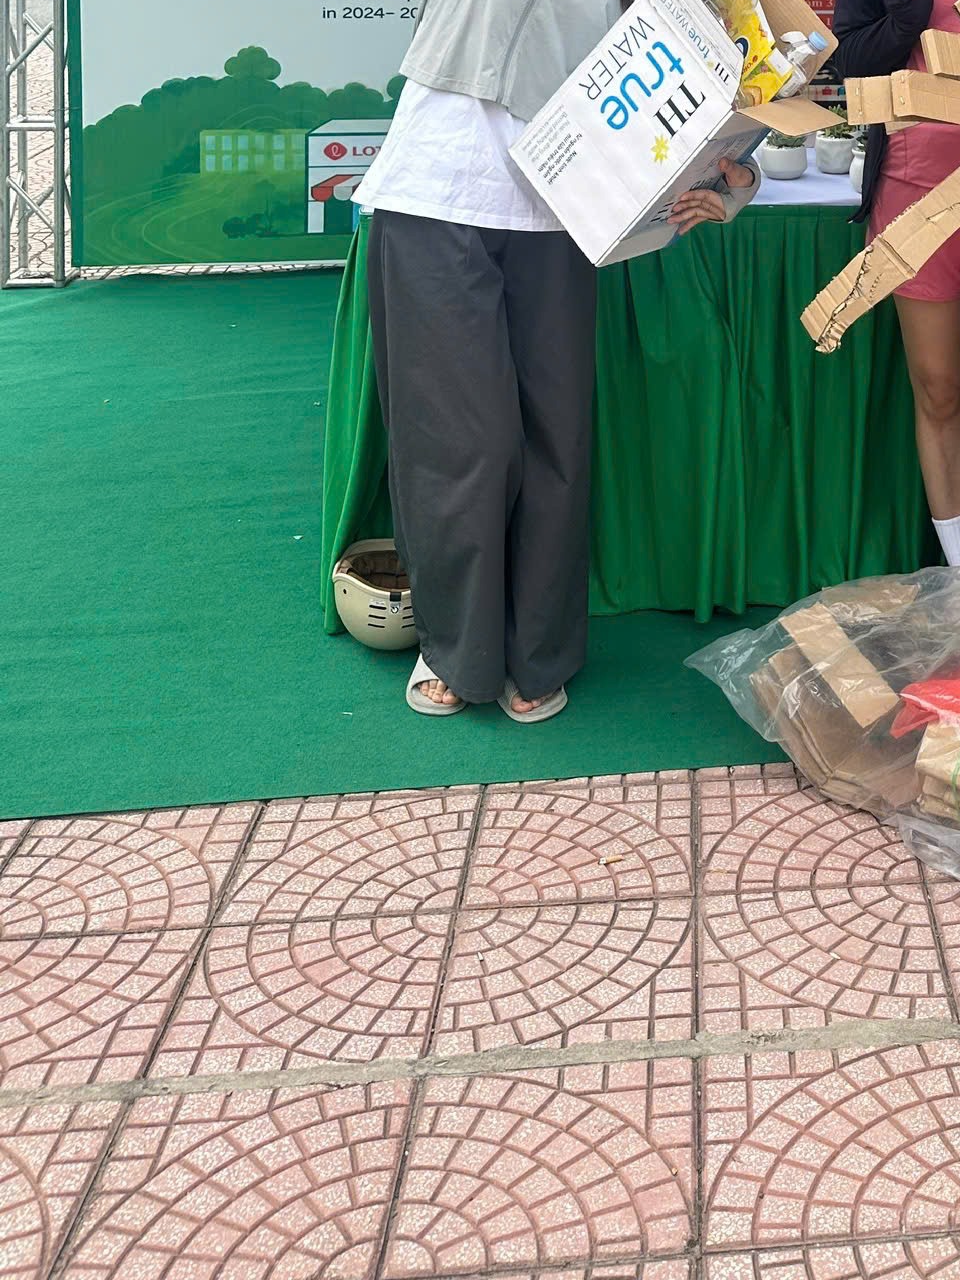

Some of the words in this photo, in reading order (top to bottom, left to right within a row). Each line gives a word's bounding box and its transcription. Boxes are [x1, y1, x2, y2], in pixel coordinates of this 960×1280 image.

[322, 7, 336, 18] in
[578, 16, 655, 100] WATER
[600, 41, 685, 130] true
[714, 62, 730, 85] TH
[653, 80, 707, 138] TH
